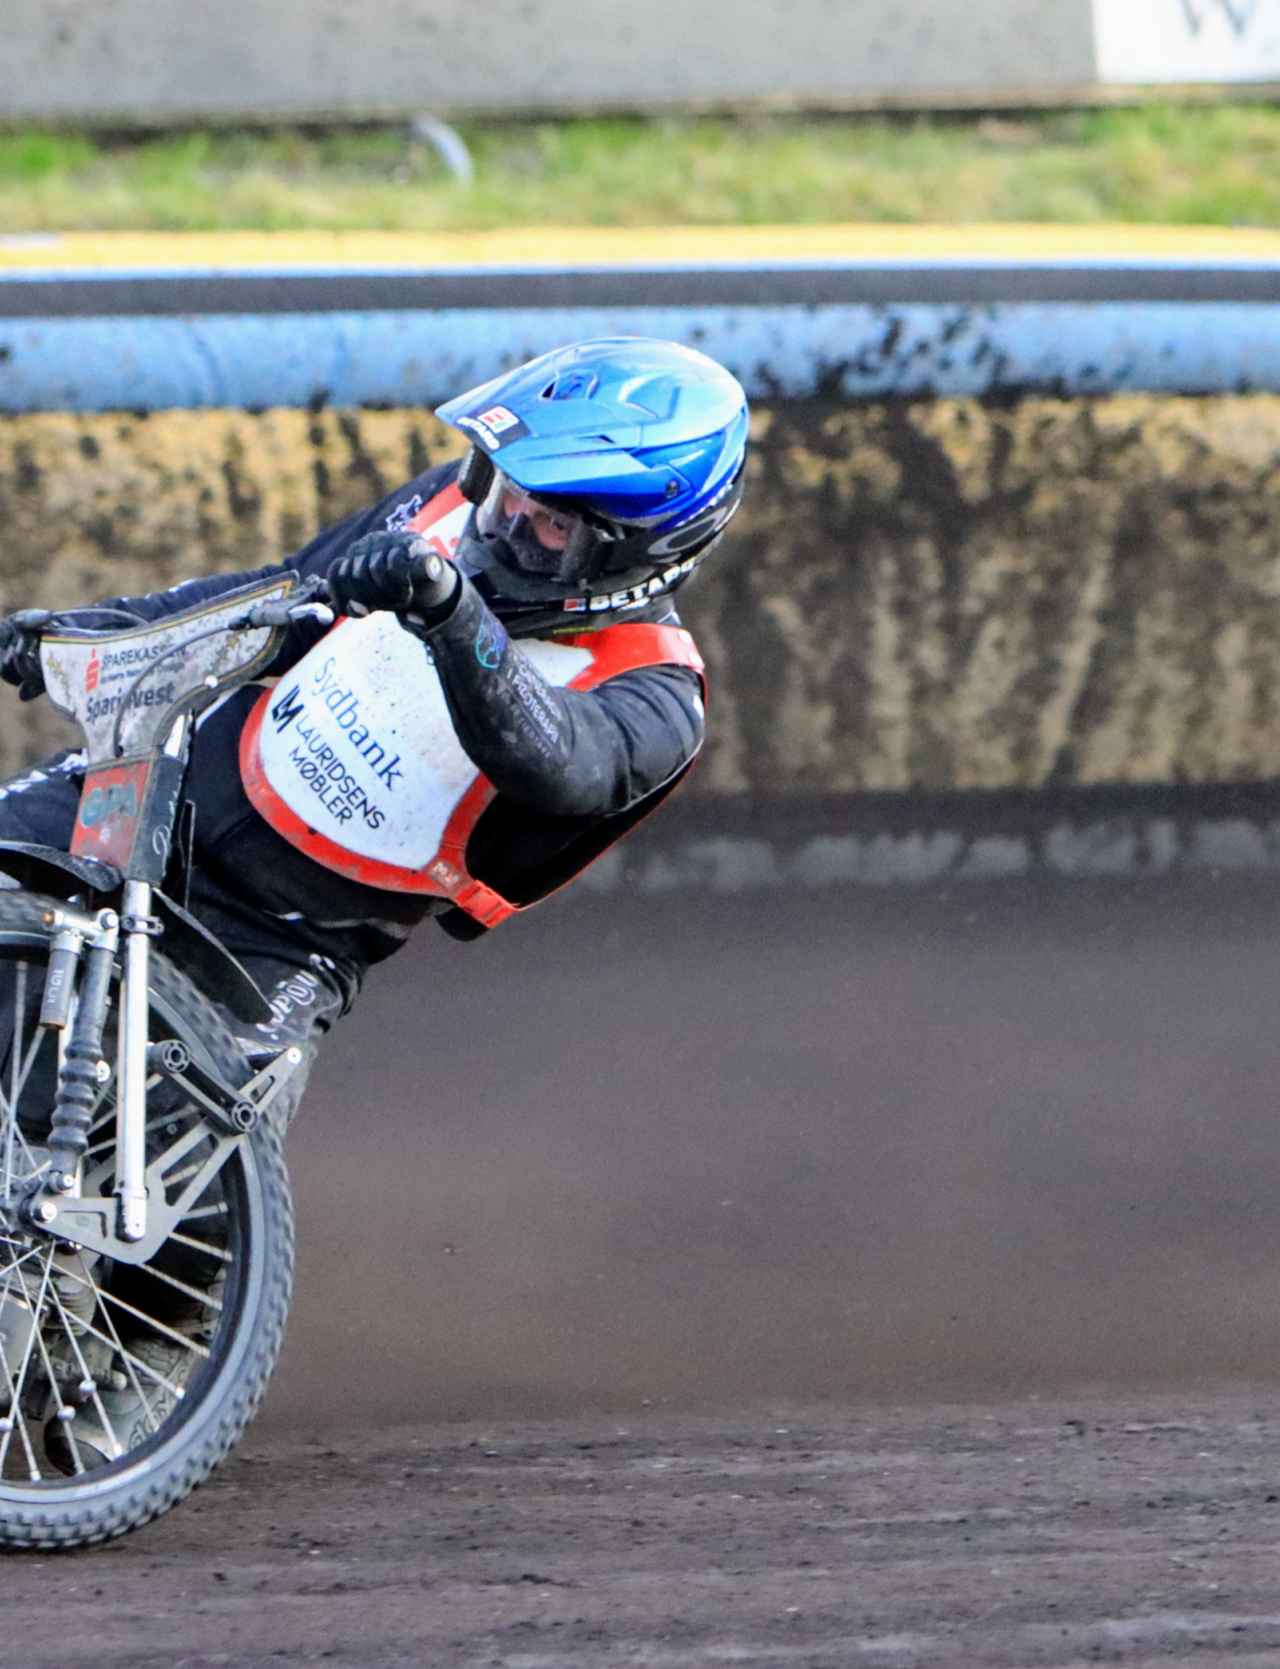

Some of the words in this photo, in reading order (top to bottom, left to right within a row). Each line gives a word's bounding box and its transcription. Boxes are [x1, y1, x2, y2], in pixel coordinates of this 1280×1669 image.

[85, 682, 175, 724] Sparivest
[313, 656, 405, 791] Sydbank
[288, 746, 354, 826] MØBLER
[295, 713, 387, 829] LAURIDSENS
